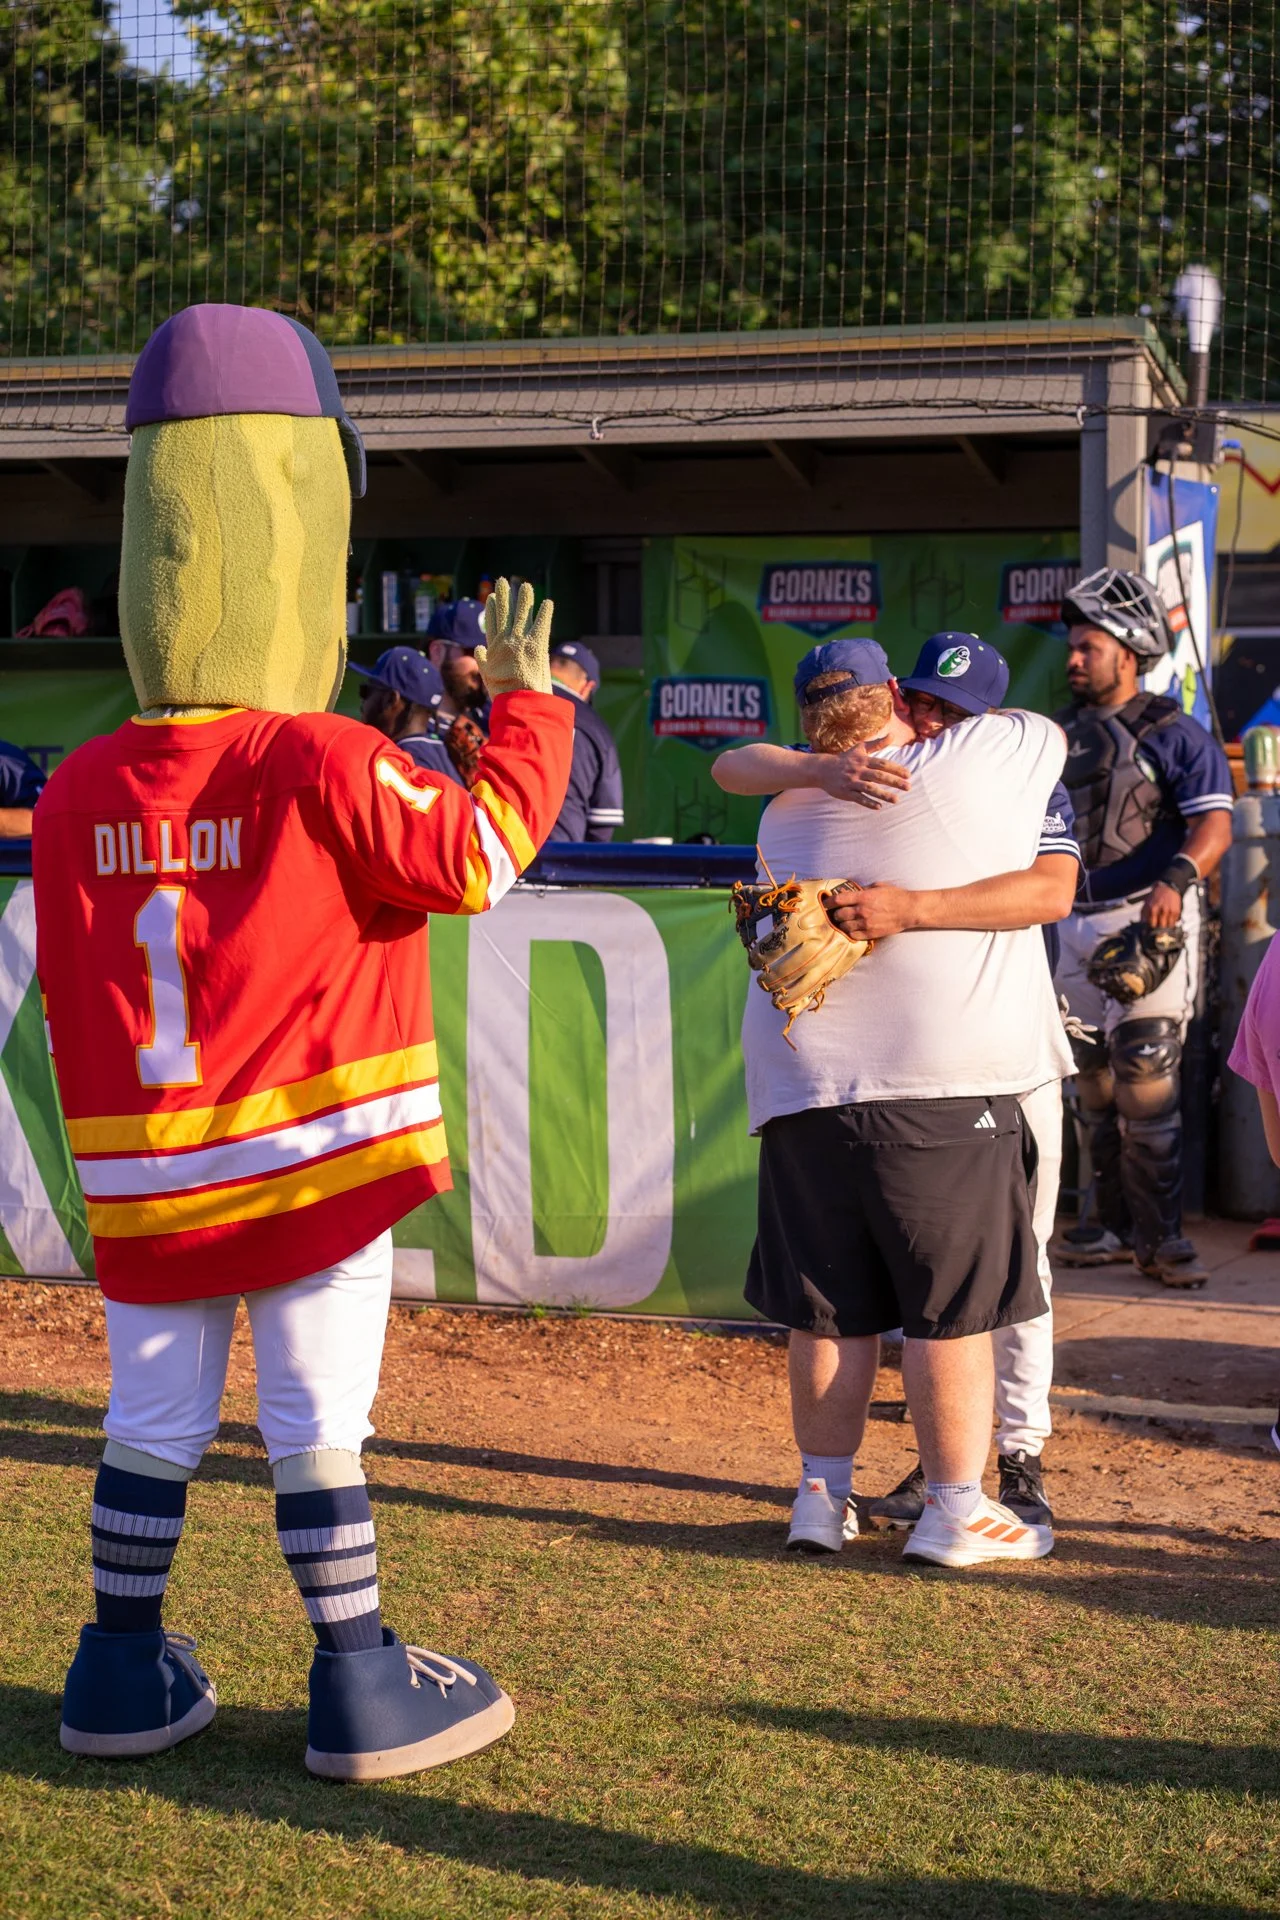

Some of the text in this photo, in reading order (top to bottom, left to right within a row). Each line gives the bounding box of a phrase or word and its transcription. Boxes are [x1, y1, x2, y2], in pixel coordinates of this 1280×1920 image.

[769, 568, 872, 603] CORNEL'S
[660, 683, 761, 719] CORNEL'S
[376, 757, 443, 814] 1
[94, 817, 243, 876] DILLON
[134, 885, 203, 1089] 1
